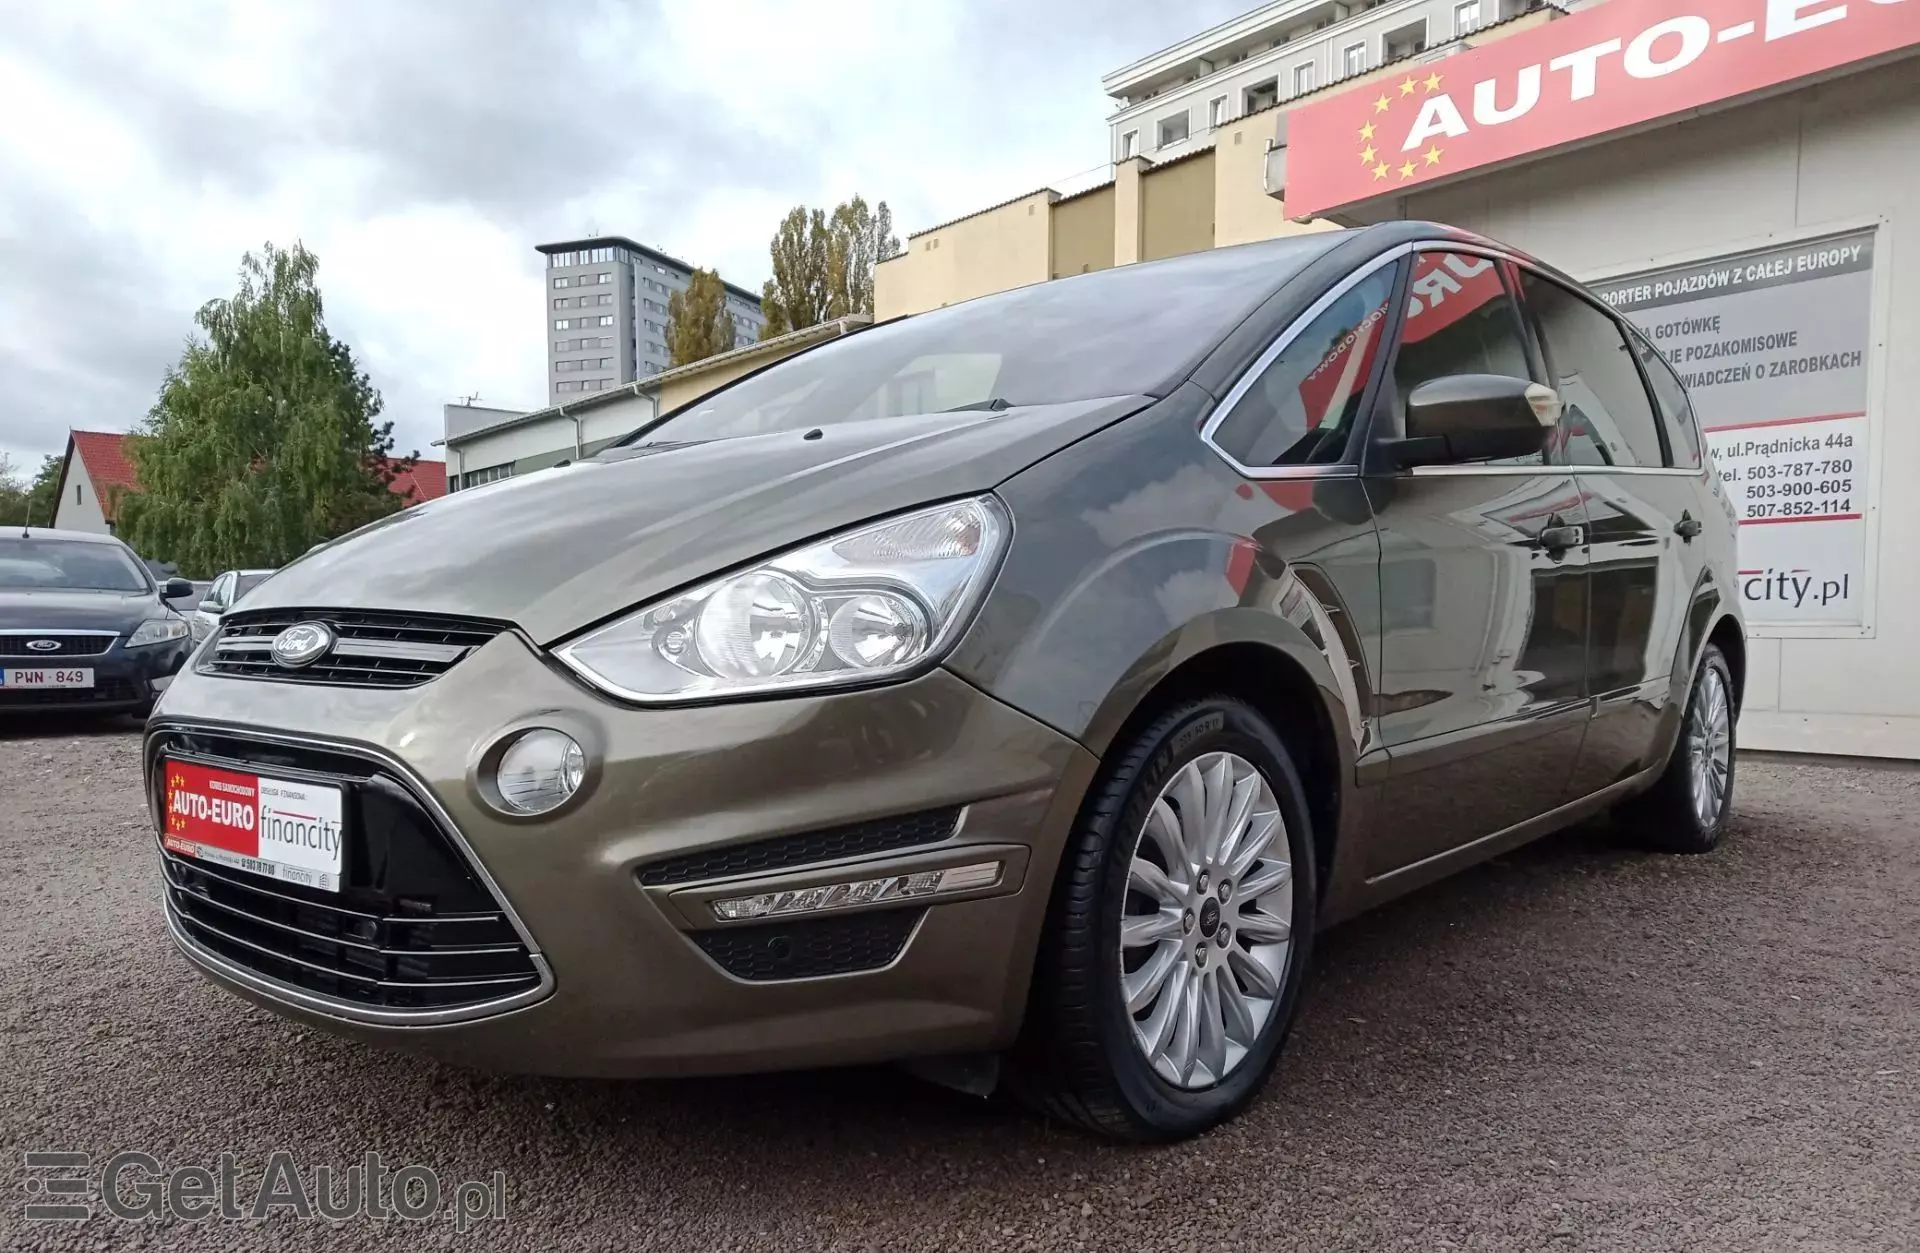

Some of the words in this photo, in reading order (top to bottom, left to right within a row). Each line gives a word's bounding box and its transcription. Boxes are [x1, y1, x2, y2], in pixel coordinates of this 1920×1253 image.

[1401, 0, 1904, 152] AUTO-E
[1602, 285, 1651, 307] PORTER
[1655, 269, 1729, 298] POJAZDÓW
[1733, 267, 1743, 284] Z
[1746, 258, 1793, 281] CAŁEJ
[1797, 244, 1861, 272] EUROPY
[1655, 315, 1721, 339] GOTÓWKĘ
[1686, 330, 1797, 362] POZAKOMISOWE
[1681, 362, 1751, 388] WIADCZEŃ
[1755, 364, 1765, 379] O
[1769, 350, 1861, 378] ZAROBKACH
[1727, 436, 1820, 457] ul.Prądnicka
[1825, 432, 1853, 448] 44a
[1747, 459, 1852, 480] 503-787-780
[1747, 479, 1852, 499] 503-900-605
[1747, 498, 1851, 518] 507-852-114
[1744, 568, 1848, 608] city.pl
[172, 789, 255, 831] AUTO-EURO
[260, 805, 342, 861] financity
